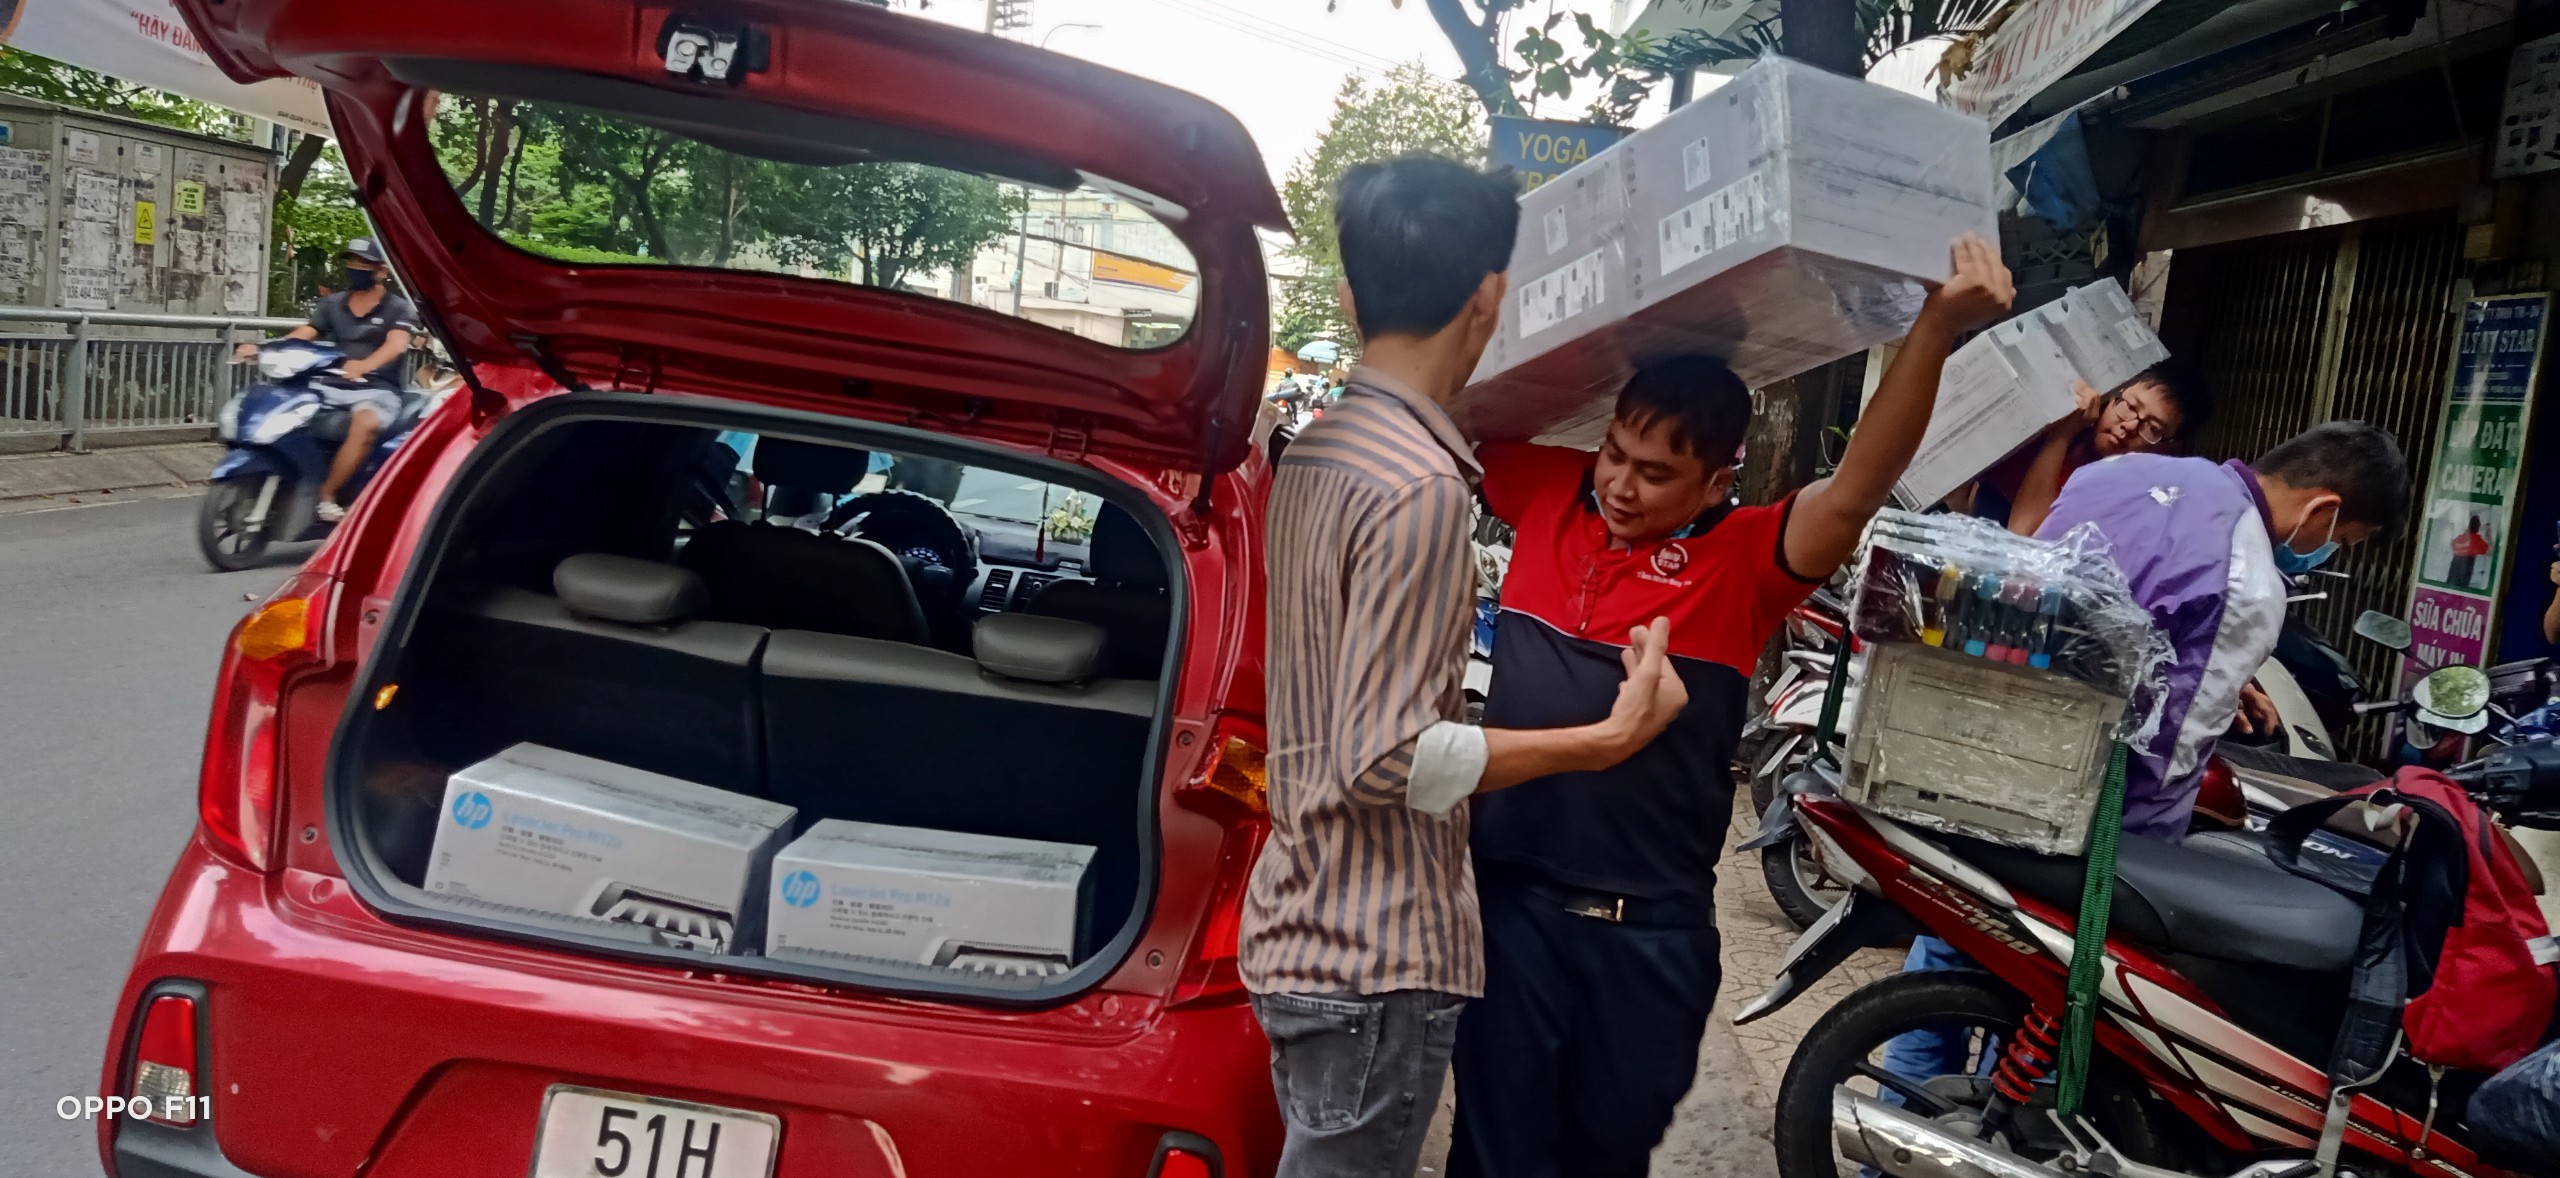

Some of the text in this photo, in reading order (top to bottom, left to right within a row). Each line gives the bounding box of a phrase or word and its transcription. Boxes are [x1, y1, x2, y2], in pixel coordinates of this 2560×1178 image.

[1519, 132, 1588, 164] YOGA
[2480, 416, 2519, 458] ĐẶT
[2441, 463, 2506, 495] CAMERA
[2442, 606, 2483, 641] CHỮA
[456, 792, 491, 829] hp
[785, 871, 820, 908] hp
[594, 1106, 721, 1178] 51H
